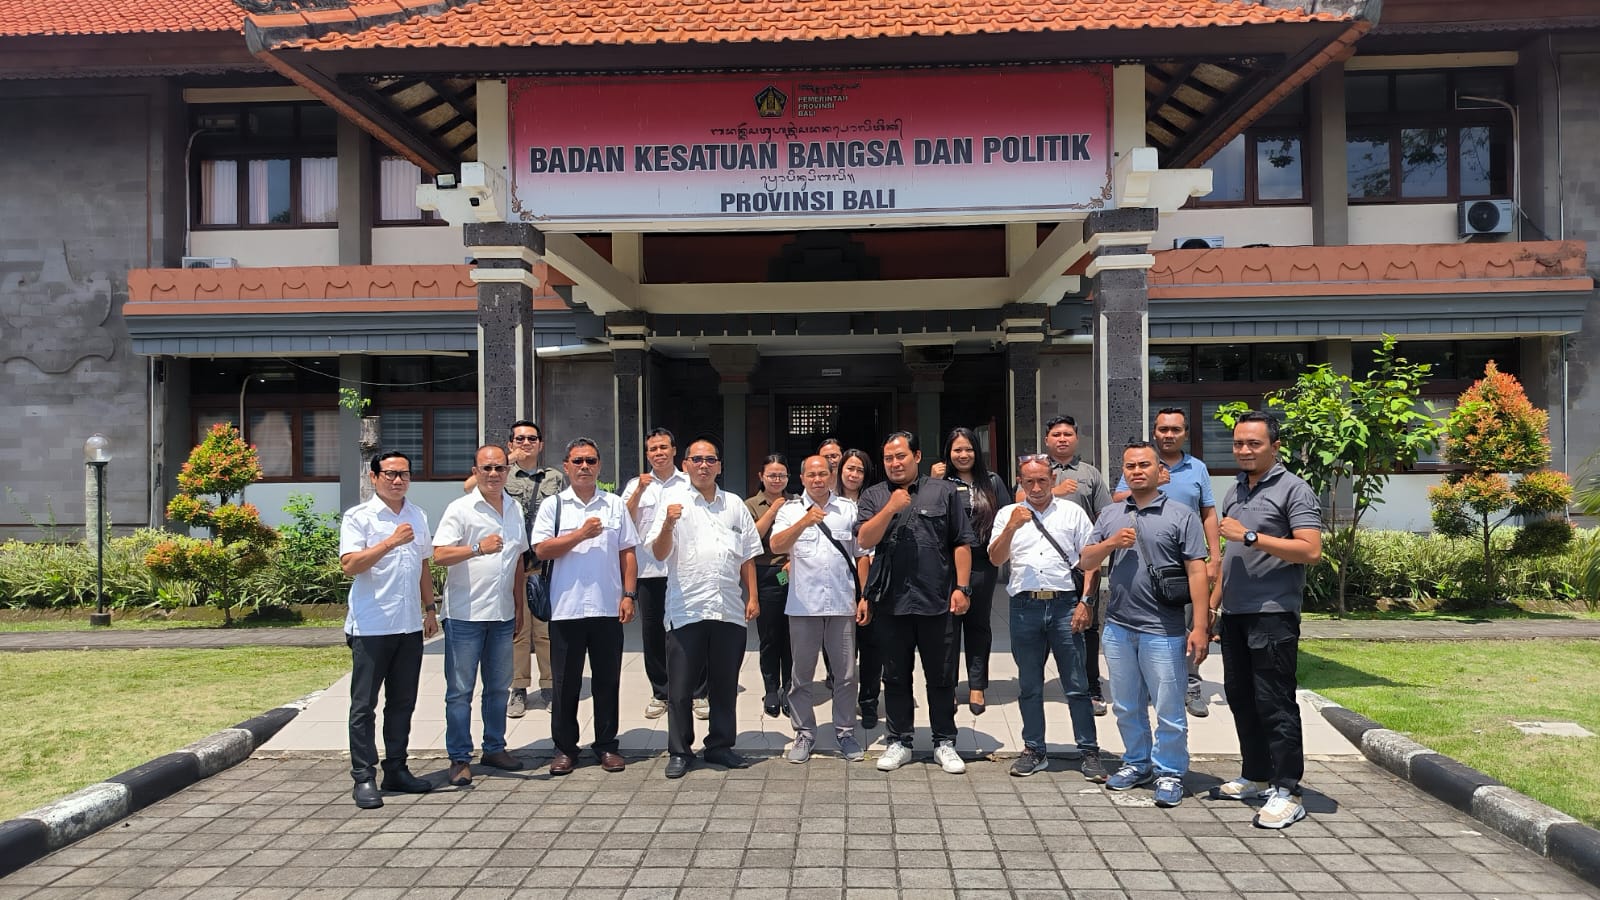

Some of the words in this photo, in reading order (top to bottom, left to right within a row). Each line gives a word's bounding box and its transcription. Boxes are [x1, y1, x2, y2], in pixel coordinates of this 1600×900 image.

[798, 95, 848, 103] PEMERINTAH
[530, 145, 625, 174] BADAN
[634, 142, 779, 172] KESATUAN
[787, 138, 904, 169] BANGSA
[914, 136, 973, 166] DAN
[982, 133, 1092, 165] POLITIK
[720, 190, 834, 213] PROVINSI
[842, 188, 896, 210] BALI
